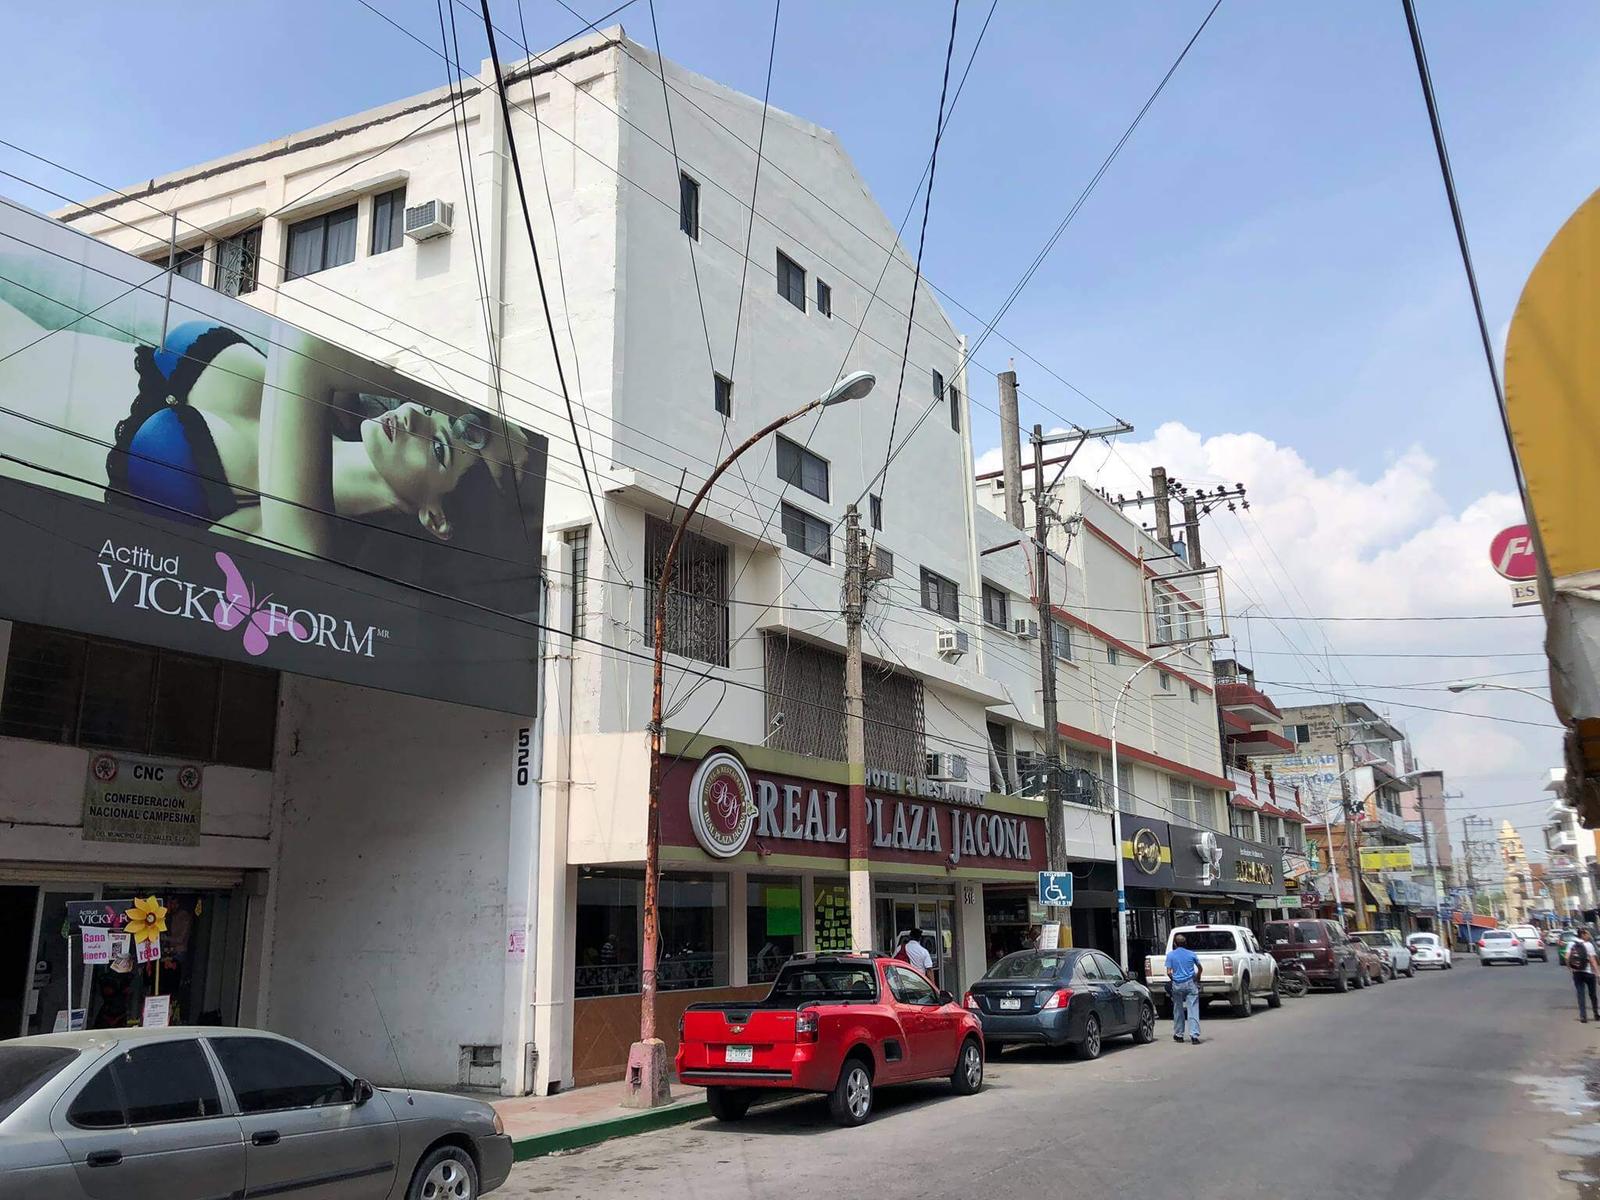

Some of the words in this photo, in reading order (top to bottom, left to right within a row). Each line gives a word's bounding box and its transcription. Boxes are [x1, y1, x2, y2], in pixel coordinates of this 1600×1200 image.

[98, 539, 180, 575] Actitud
[97, 562, 242, 627] VICKY
[265, 601, 376, 658] FORM
[517, 727, 530, 786] 520
[133, 765, 164, 781] CNC
[917, 780, 985, 806] RESTAURANT
[89, 805, 140, 820] NACIONAL
[142, 809, 197, 824] CAMPESINA
[756, 779, 847, 844] REAL
[949, 808, 1032, 864] JACONA
[80, 913, 113, 924] VICKY
[83, 933, 106, 943] Gana
